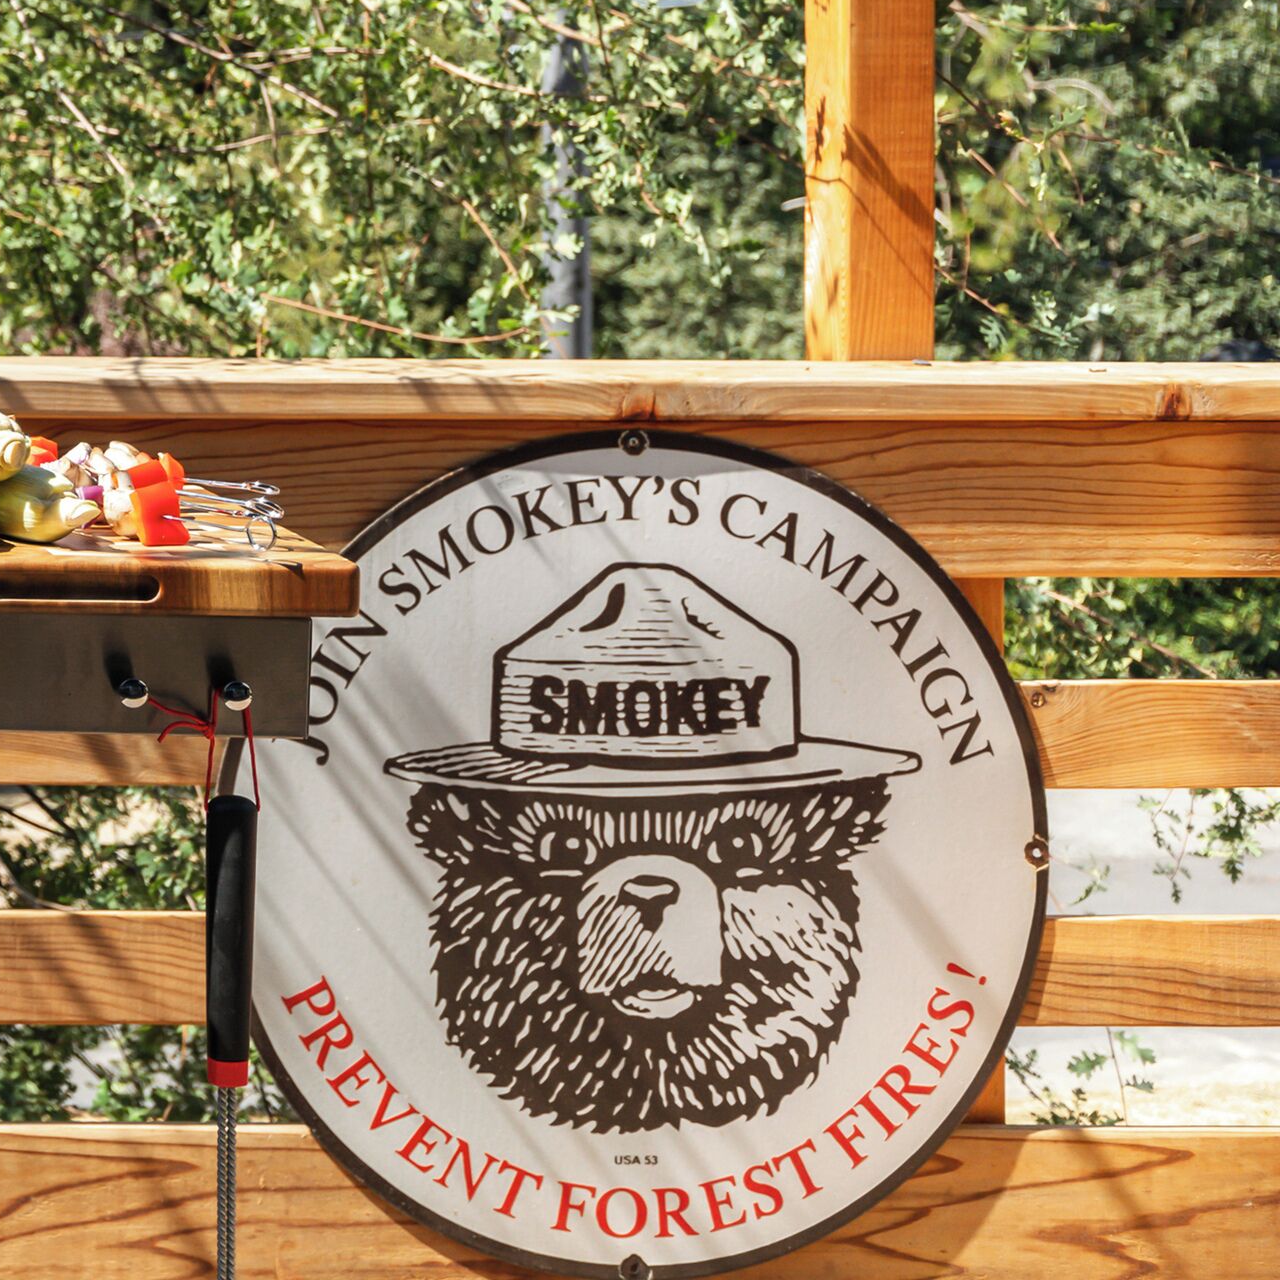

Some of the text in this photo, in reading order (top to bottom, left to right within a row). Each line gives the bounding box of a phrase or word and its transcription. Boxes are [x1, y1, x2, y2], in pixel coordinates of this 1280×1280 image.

[378, 475, 701, 616] SMOKEY'S
[720, 494, 994, 766] CAMPAIGN
[529, 674, 771, 736] SMOKEY
[282, 962, 987, 1239] PREVENT FOREST FIRES!
[614, 1155, 640, 1165] USA
